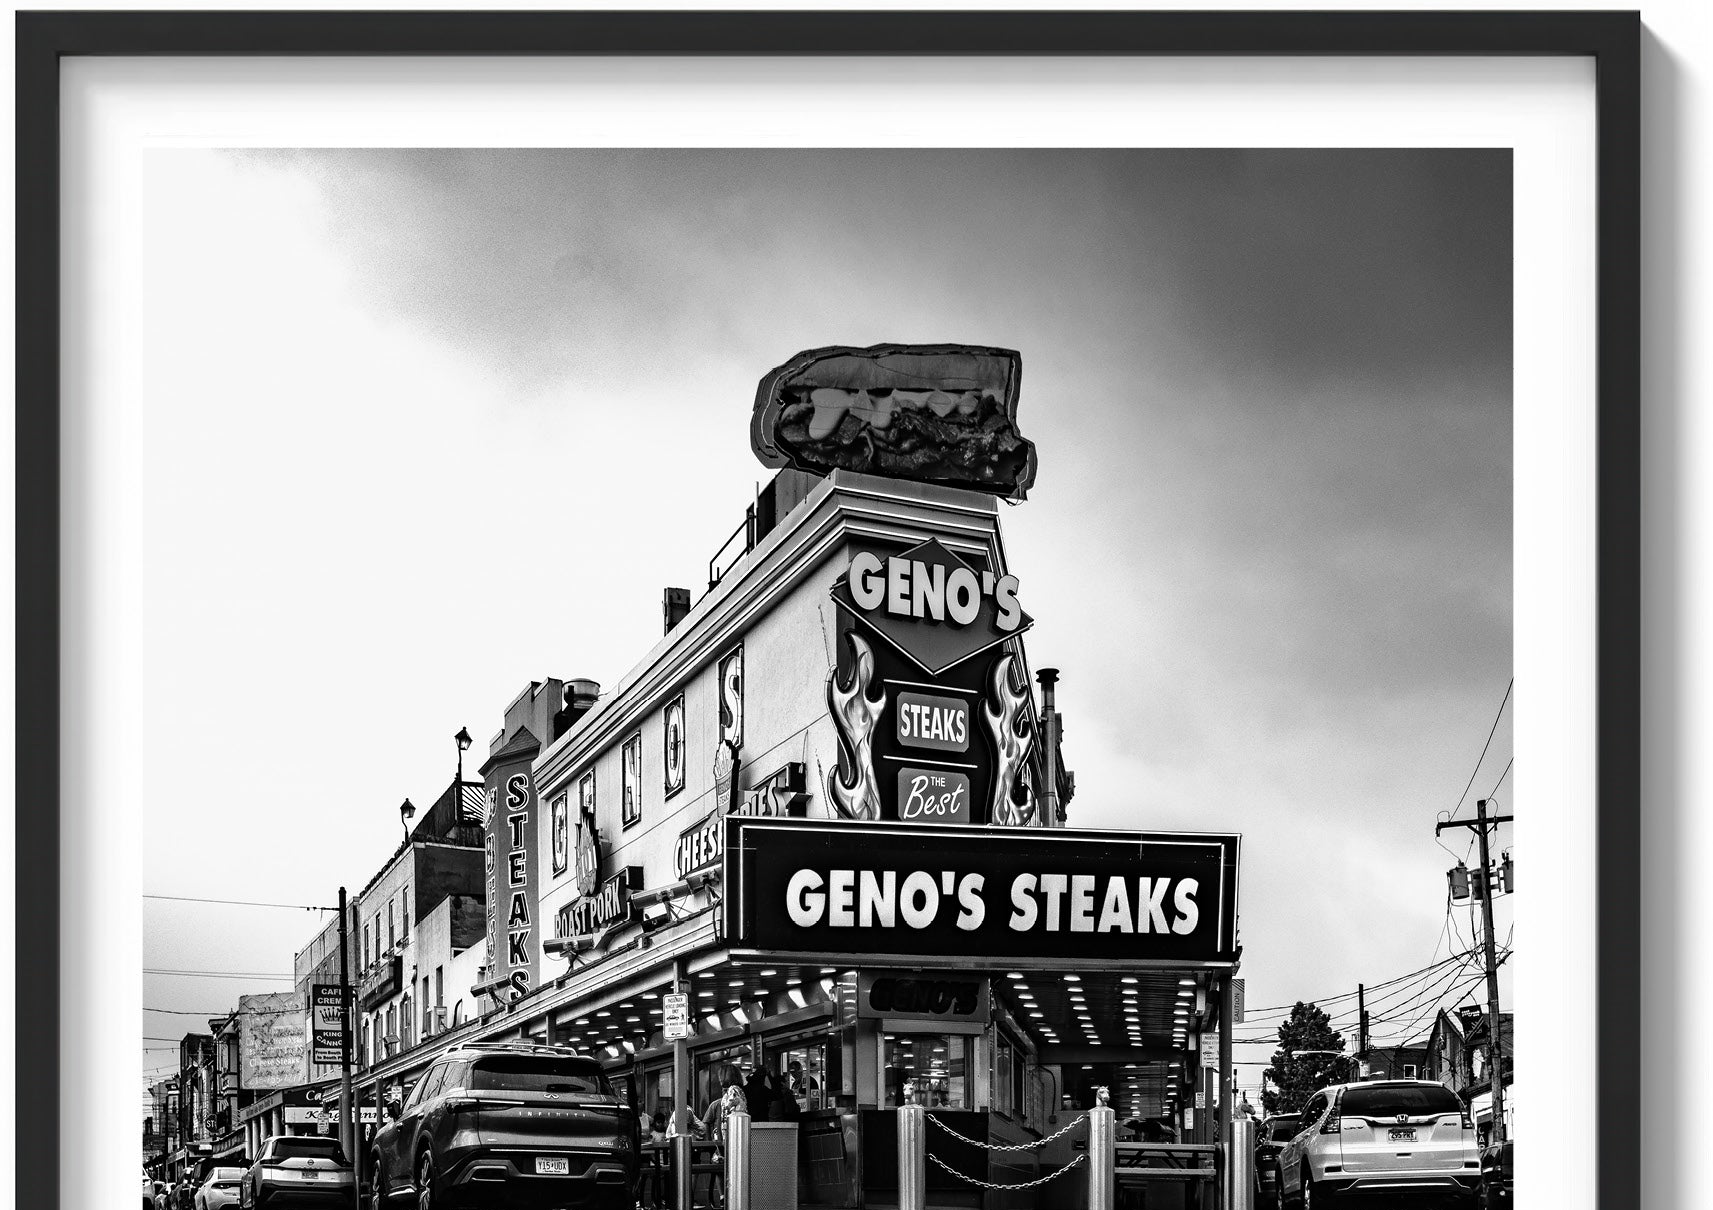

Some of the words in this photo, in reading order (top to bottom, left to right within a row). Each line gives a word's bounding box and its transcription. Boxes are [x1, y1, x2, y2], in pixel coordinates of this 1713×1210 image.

[849, 551, 1022, 632] GENO'S
[901, 703, 966, 744] STEAKS
[903, 775, 965, 819] Best
[930, 776, 946, 788] THE
[506, 773, 531, 1001] STEAKS
[554, 902, 587, 939] ROAST
[589, 876, 621, 928] PORK
[786, 868, 986, 932] GENO'S
[1009, 873, 1200, 936] STEAKS
[317, 997, 341, 1005] CREM
[1233, 992, 1241, 1022] CAUTION
[316, 1035, 342, 1047] CANNO
[306, 1090, 323, 1101] Ca
